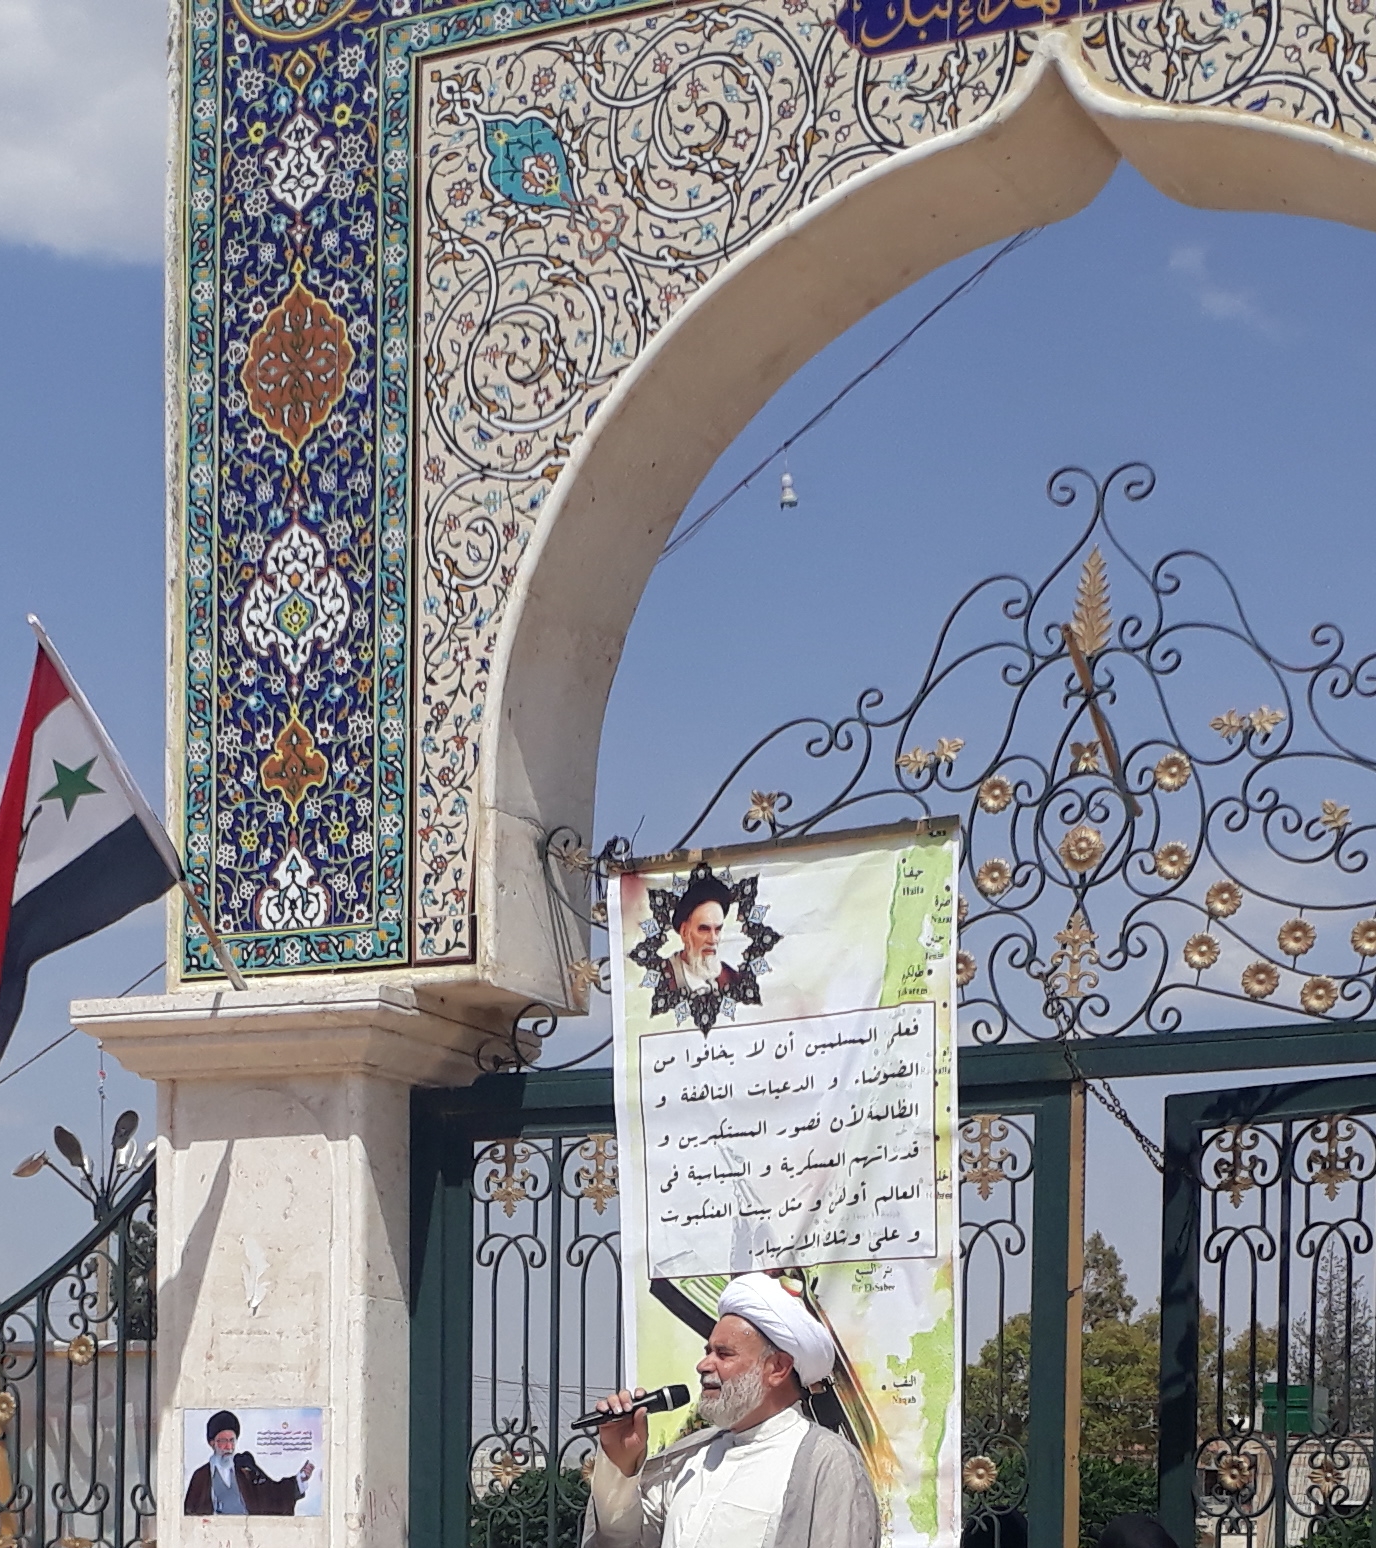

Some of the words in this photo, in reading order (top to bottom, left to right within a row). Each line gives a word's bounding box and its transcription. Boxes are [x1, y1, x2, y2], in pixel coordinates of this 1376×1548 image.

[746, 1039, 765, 1058] لا
[774, 1031, 795, 1059] أن
[804, 1026, 877, 1057] المسلمين
[654, 1055, 676, 1073] من
[686, 1042, 734, 1068] يخافوا
[828, 1076, 838, 1089] و
[656, 1095, 666, 1108] و
[866, 1098, 919, 1120] الظالمة
[830, 1104, 864, 1133] لأن
[658, 1135, 670, 1148] و
[679, 1118, 767, 1149] المستكبرين
[780, 1148, 846, 1179] العسكرية
[848, 1141, 920, 1176] قدراتهم
[687, 1162, 751, 1187] السياسية
[760, 1163, 772, 1177] و
[778, 1197, 802, 1217] مثل
[810, 1198, 822, 1212] و
[874, 1184, 920, 1216] العالم
[660, 1198, 732, 1226] العنكبوت
[739, 1205, 772, 1220] بيت
[907, 1230, 920, 1242] و
